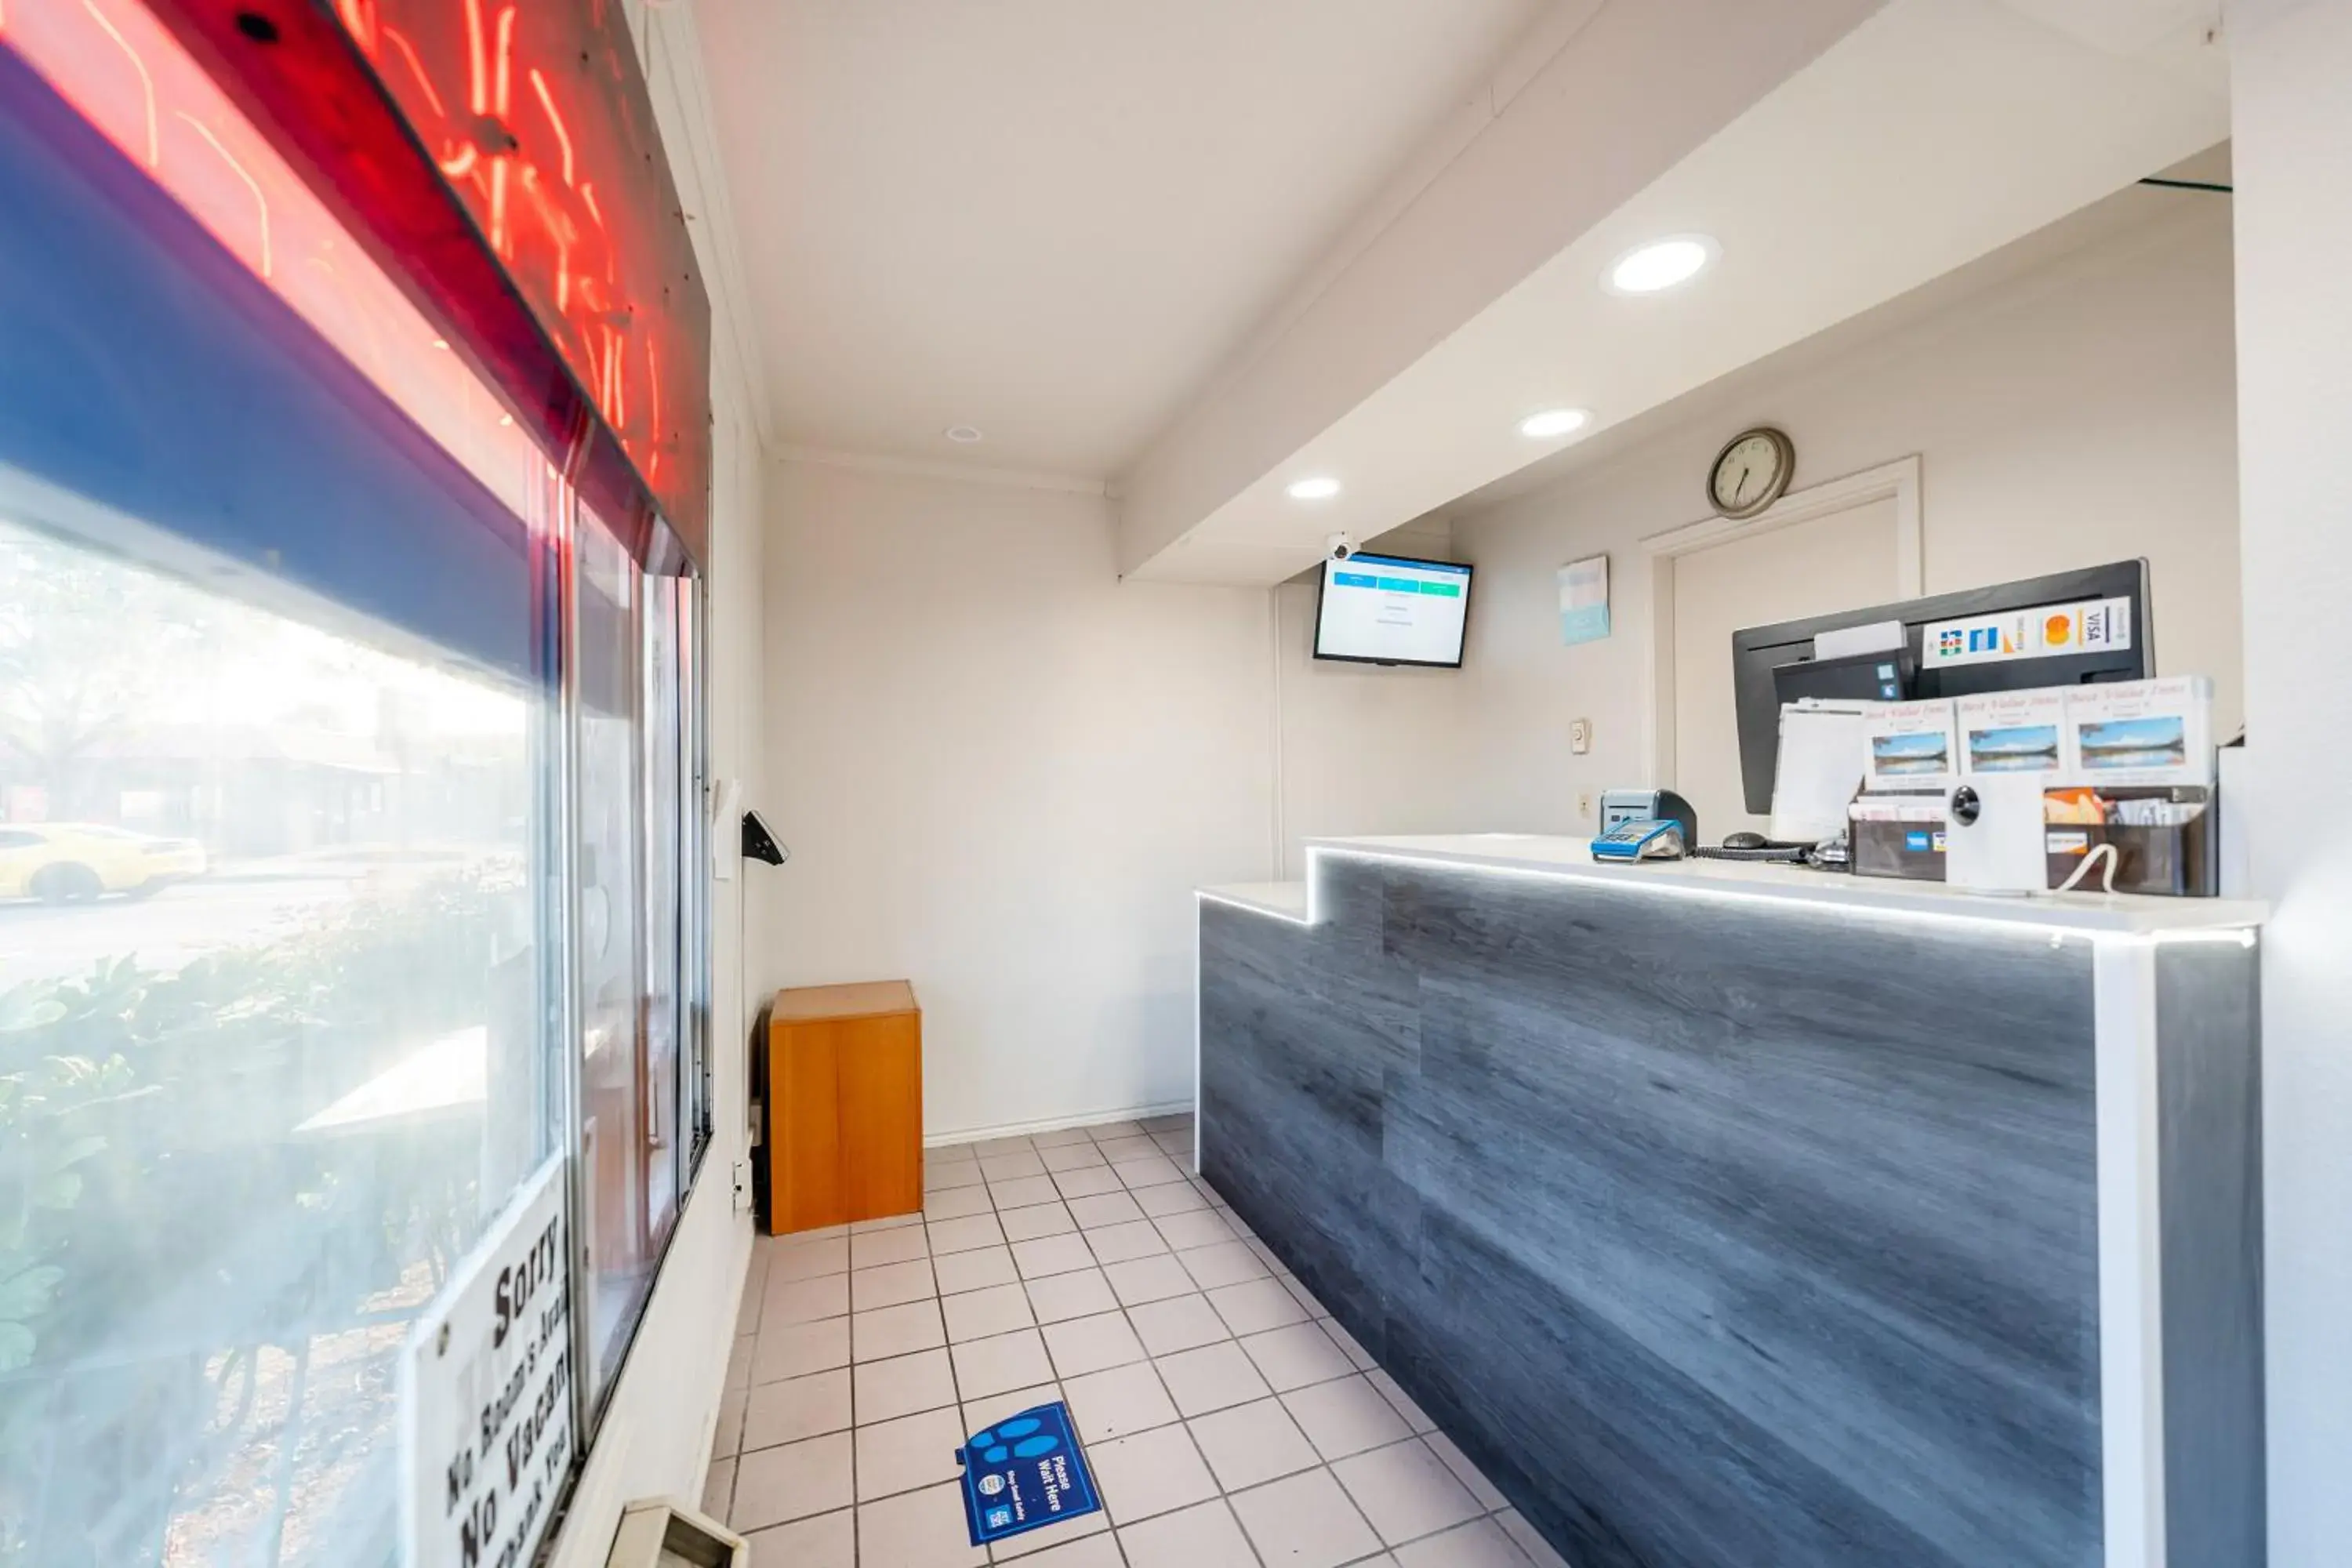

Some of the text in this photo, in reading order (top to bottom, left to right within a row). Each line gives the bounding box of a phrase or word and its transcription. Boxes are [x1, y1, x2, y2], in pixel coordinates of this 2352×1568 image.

[2087, 612, 2100, 641] VISA
[492, 1214, 558, 1350] Sorry
[446, 1446, 474, 1519] No
[1038, 1458, 1062, 1512] Wait Here
[1051, 1454, 1071, 1490] Please
[461, 1487, 497, 1568] No
